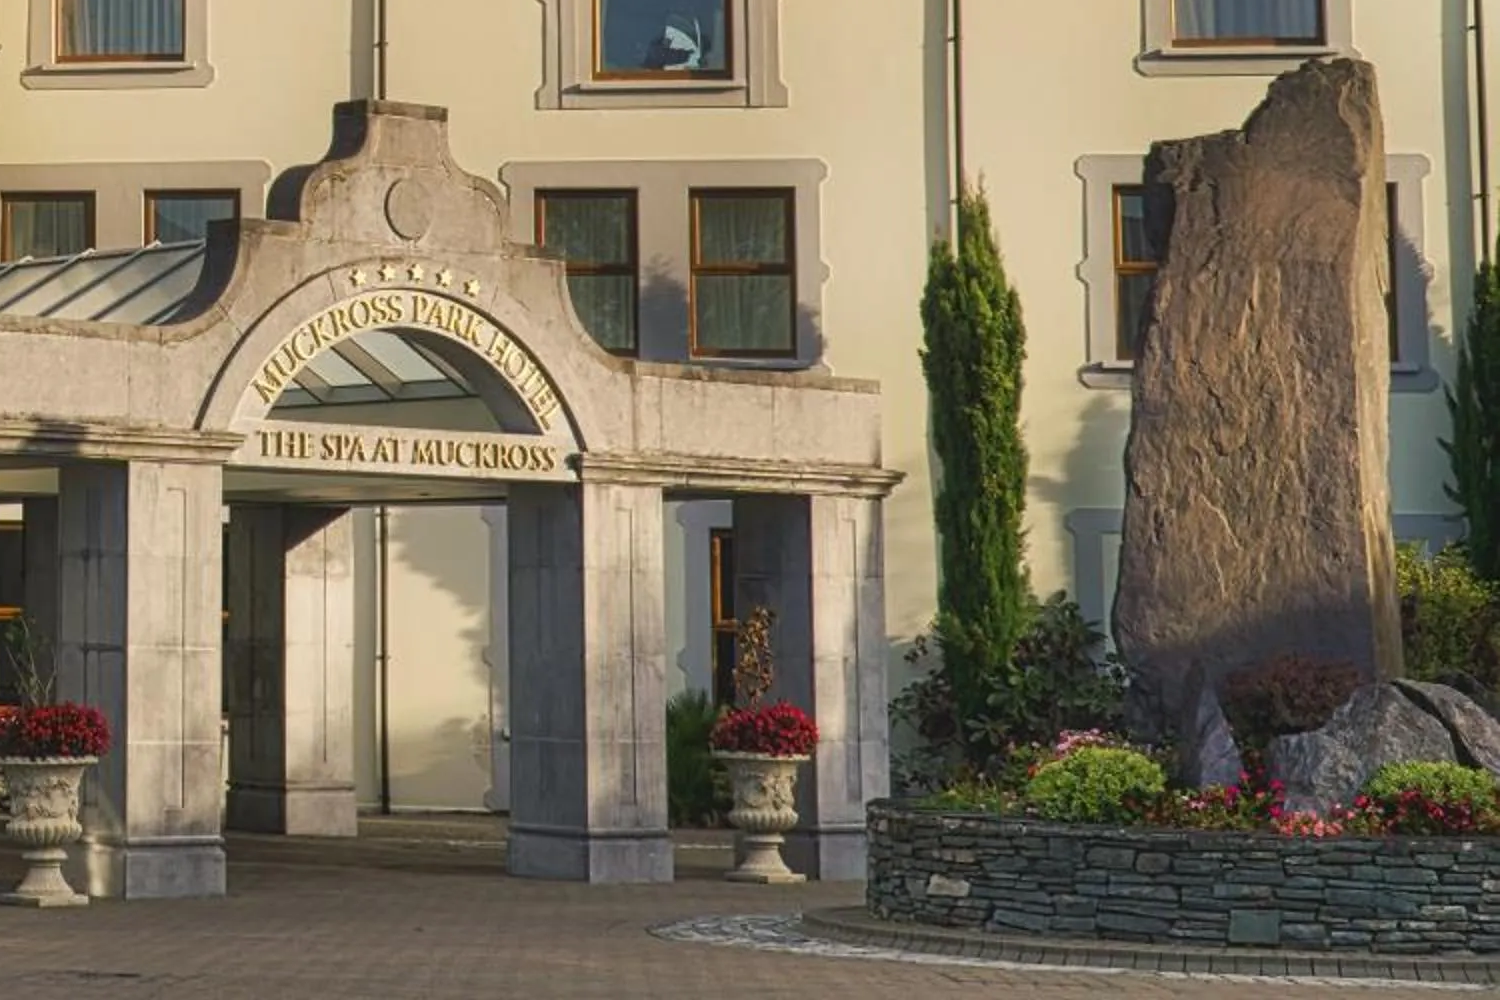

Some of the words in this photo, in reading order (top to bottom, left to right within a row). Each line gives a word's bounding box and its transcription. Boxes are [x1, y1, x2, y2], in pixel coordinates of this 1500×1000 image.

[252, 294, 405, 406] MUCKROSS
[413, 294, 485, 348] PARK
[484, 331, 563, 431] HOTEL
[256, 430, 314, 459] THE
[320, 433, 367, 461] SPA
[370, 435, 404, 463] AT
[411, 439, 558, 471] MUCKROSS
